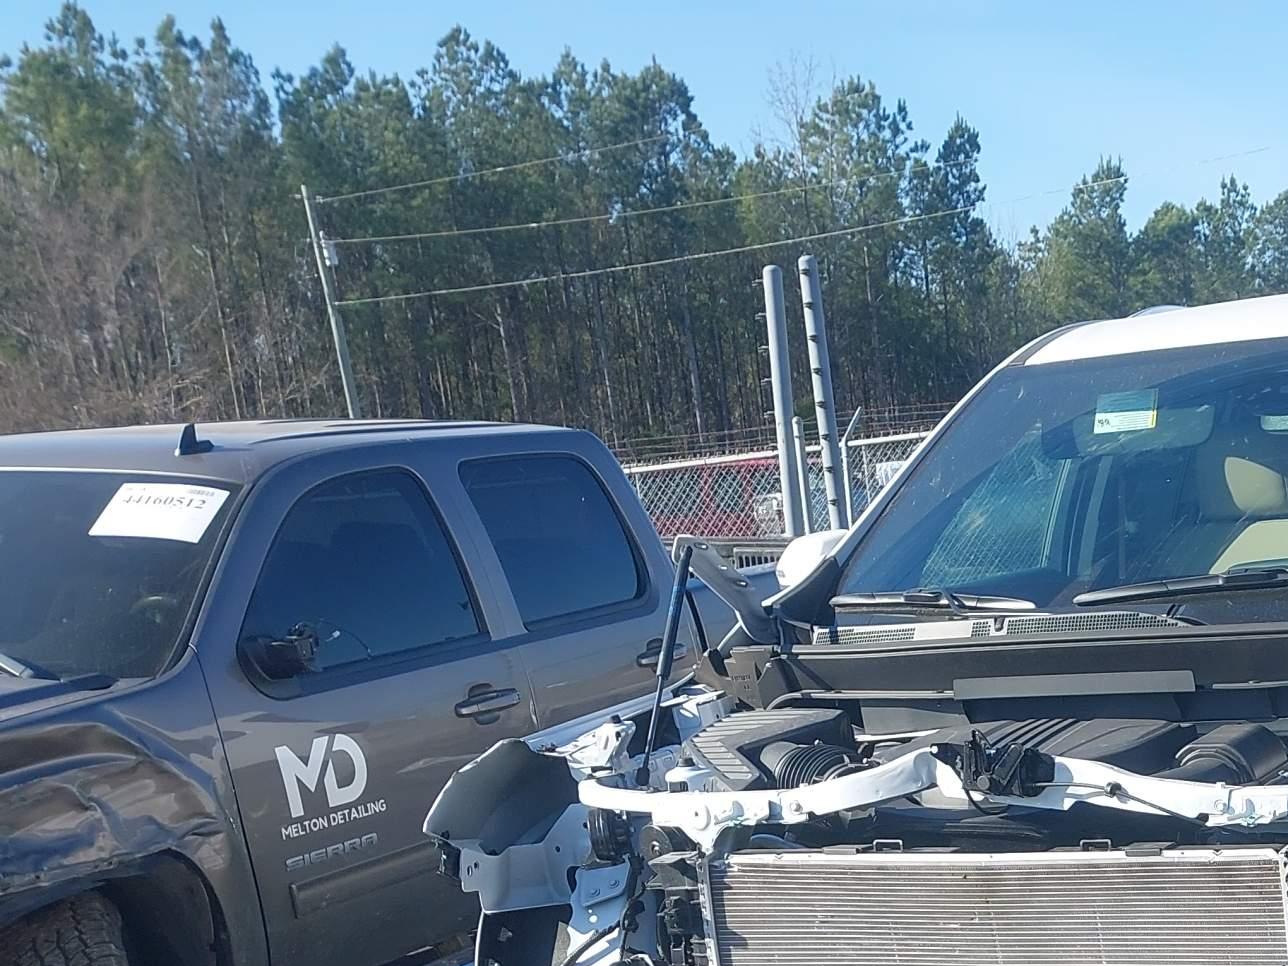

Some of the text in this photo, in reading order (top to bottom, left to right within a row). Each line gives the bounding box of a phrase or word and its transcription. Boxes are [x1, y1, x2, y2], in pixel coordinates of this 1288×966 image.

[122, 495, 207, 510] 44160512
[274, 733, 368, 819] MD
[281, 799, 387, 841] MELTON DETAILING
[285, 832, 379, 872] SIERRA
